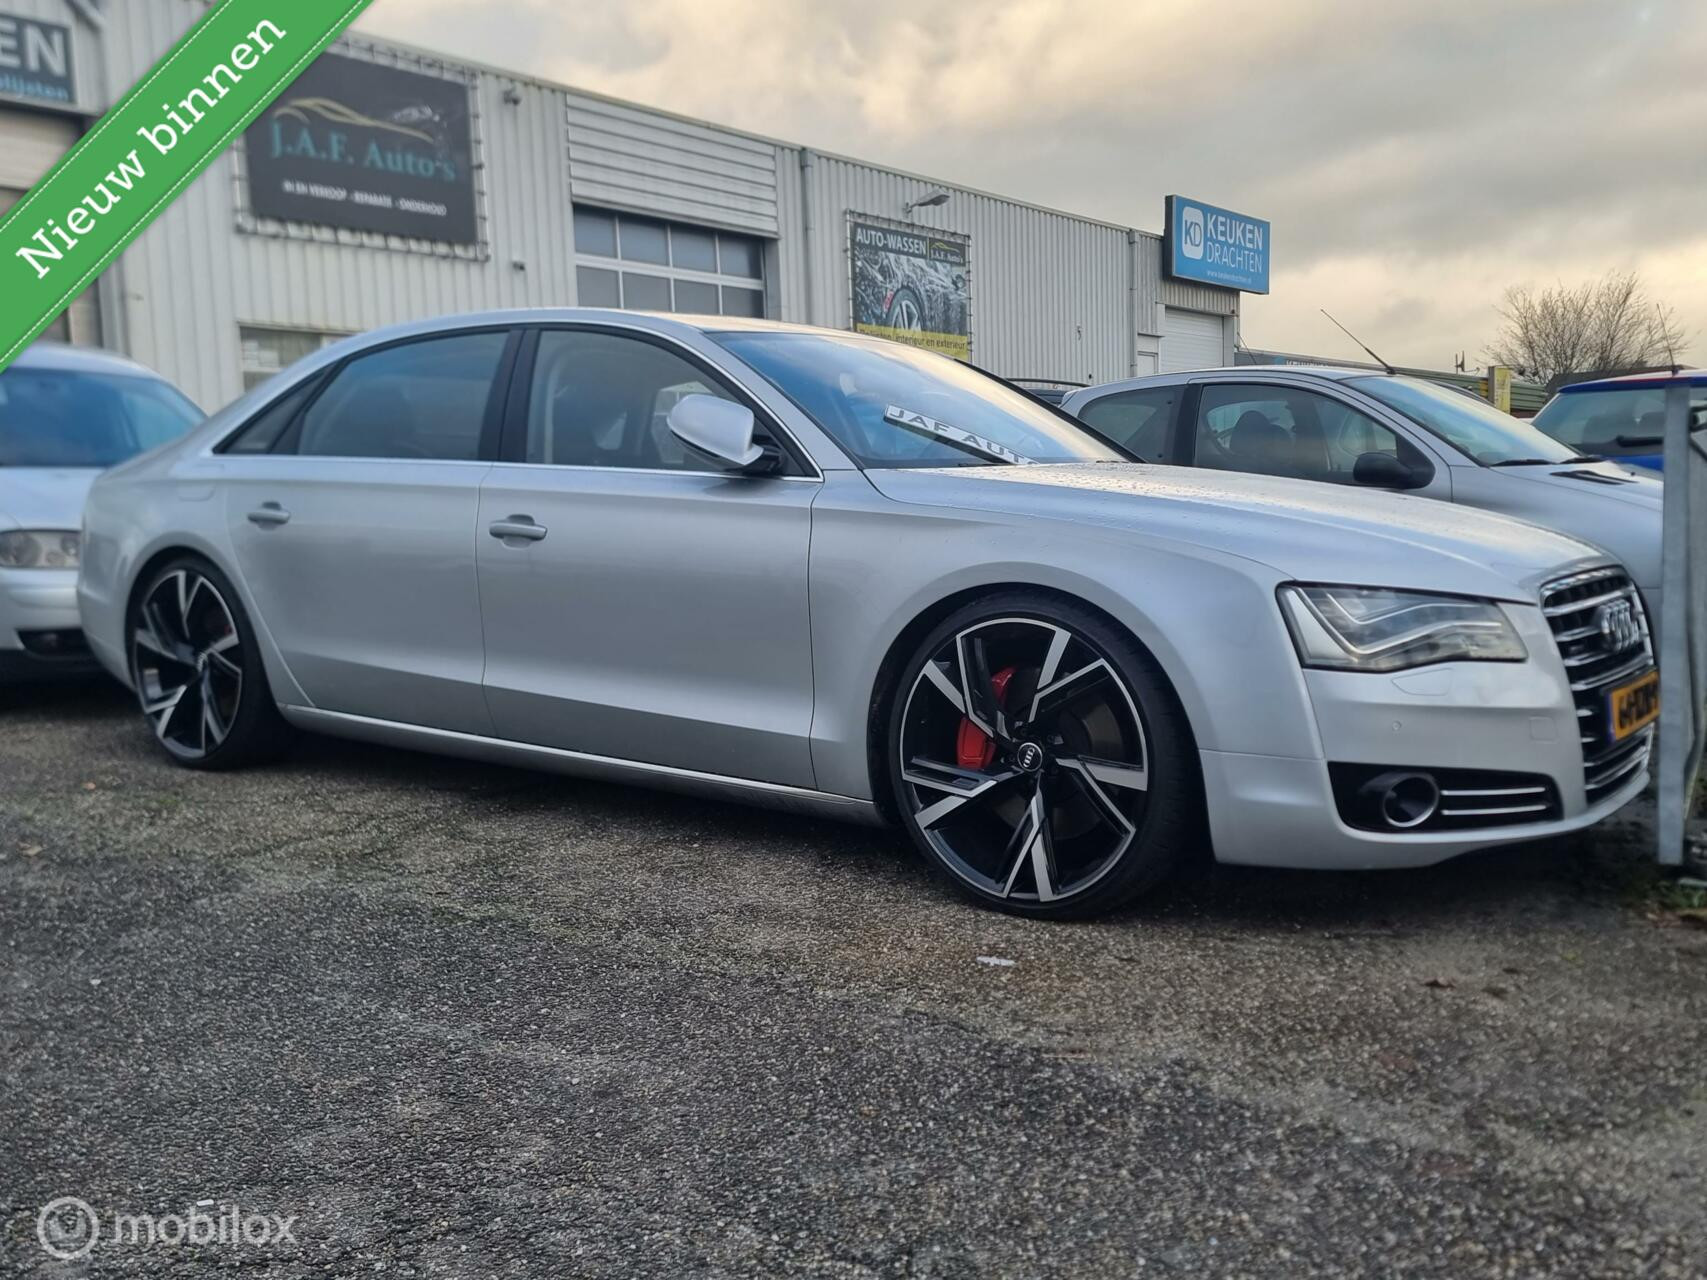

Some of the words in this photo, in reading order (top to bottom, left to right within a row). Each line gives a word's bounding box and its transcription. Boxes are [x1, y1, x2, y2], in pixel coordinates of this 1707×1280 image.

[271, 120, 355, 166] J.A.F.
[364, 139, 456, 182] Auto's
[856, 227, 927, 255] AUTO-WASSEN
[1207, 212, 1263, 251] KEUKEN
[1206, 241, 1262, 274] DRACHTEN
[926, 338, 935, 347] en
[889, 409, 951, 433] JAF
[961, 434, 1039, 465] AUT
